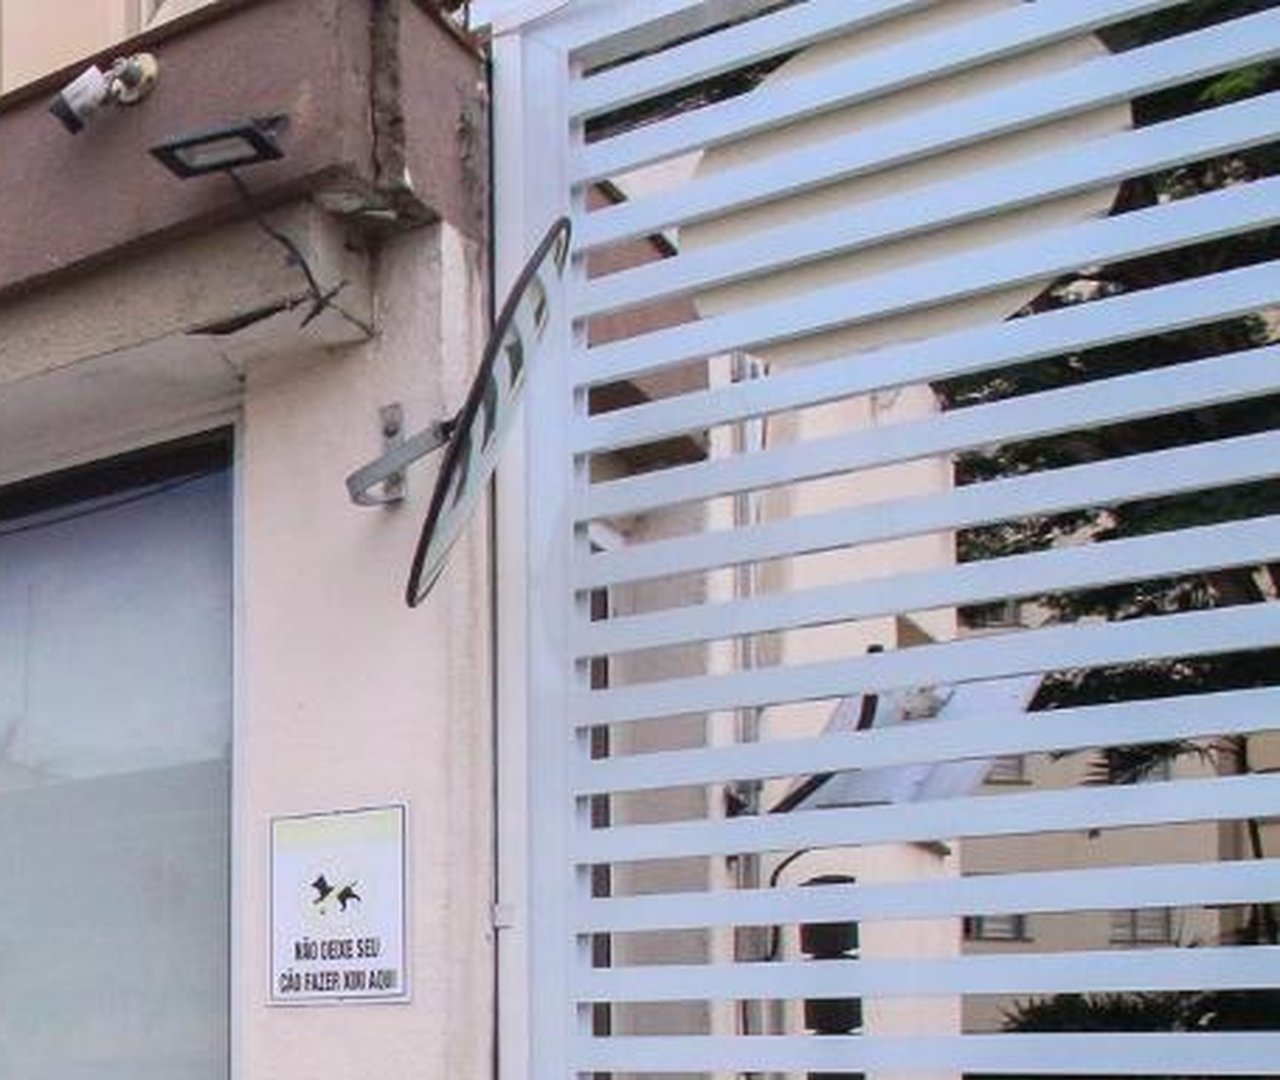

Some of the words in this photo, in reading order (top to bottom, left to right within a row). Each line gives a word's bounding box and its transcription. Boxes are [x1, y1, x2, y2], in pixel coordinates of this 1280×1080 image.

[295, 937, 318, 960] NÃO
[320, 939, 354, 960] DEIXE
[356, 938, 381, 959] SEU
[304, 971, 341, 991] FAZER
[368, 969, 398, 990] AQUI
